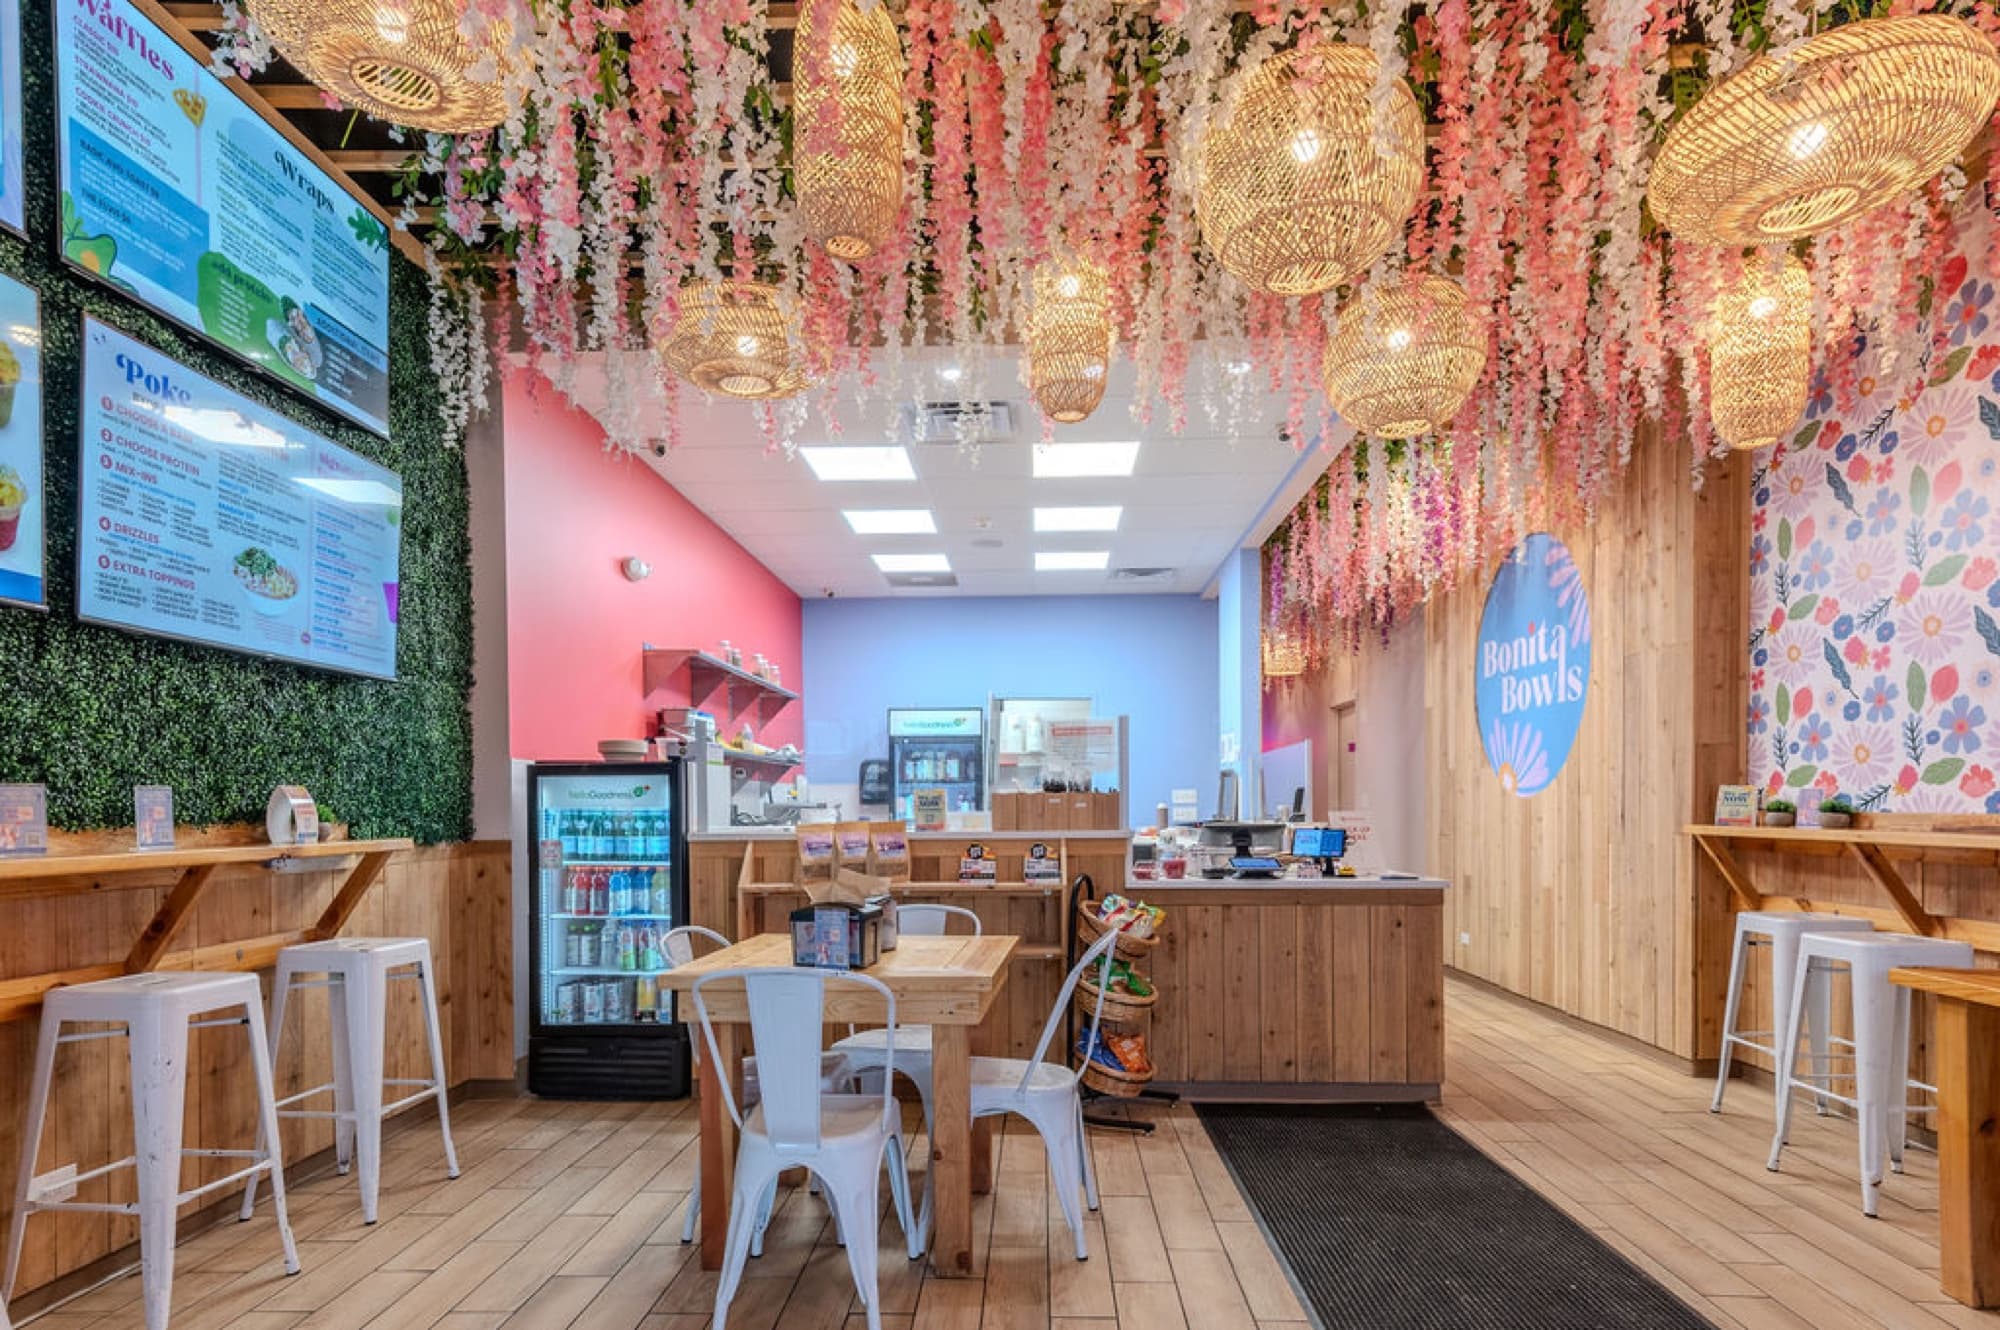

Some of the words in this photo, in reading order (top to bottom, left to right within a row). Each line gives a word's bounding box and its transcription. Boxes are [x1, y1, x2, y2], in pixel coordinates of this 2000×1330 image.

[274, 150, 335, 214] Wraps
[115, 353, 191, 402] Poke
[115, 433, 158, 460] CHOOSE
[159, 451, 200, 477] PROTEIN
[113, 521, 160, 545] DRIZZLES
[112, 559, 146, 578] EXTRA
[148, 568, 196, 591] TOPPINGS
[1483, 618, 1567, 679] Bonita
[1501, 662, 1583, 715] Bowls
